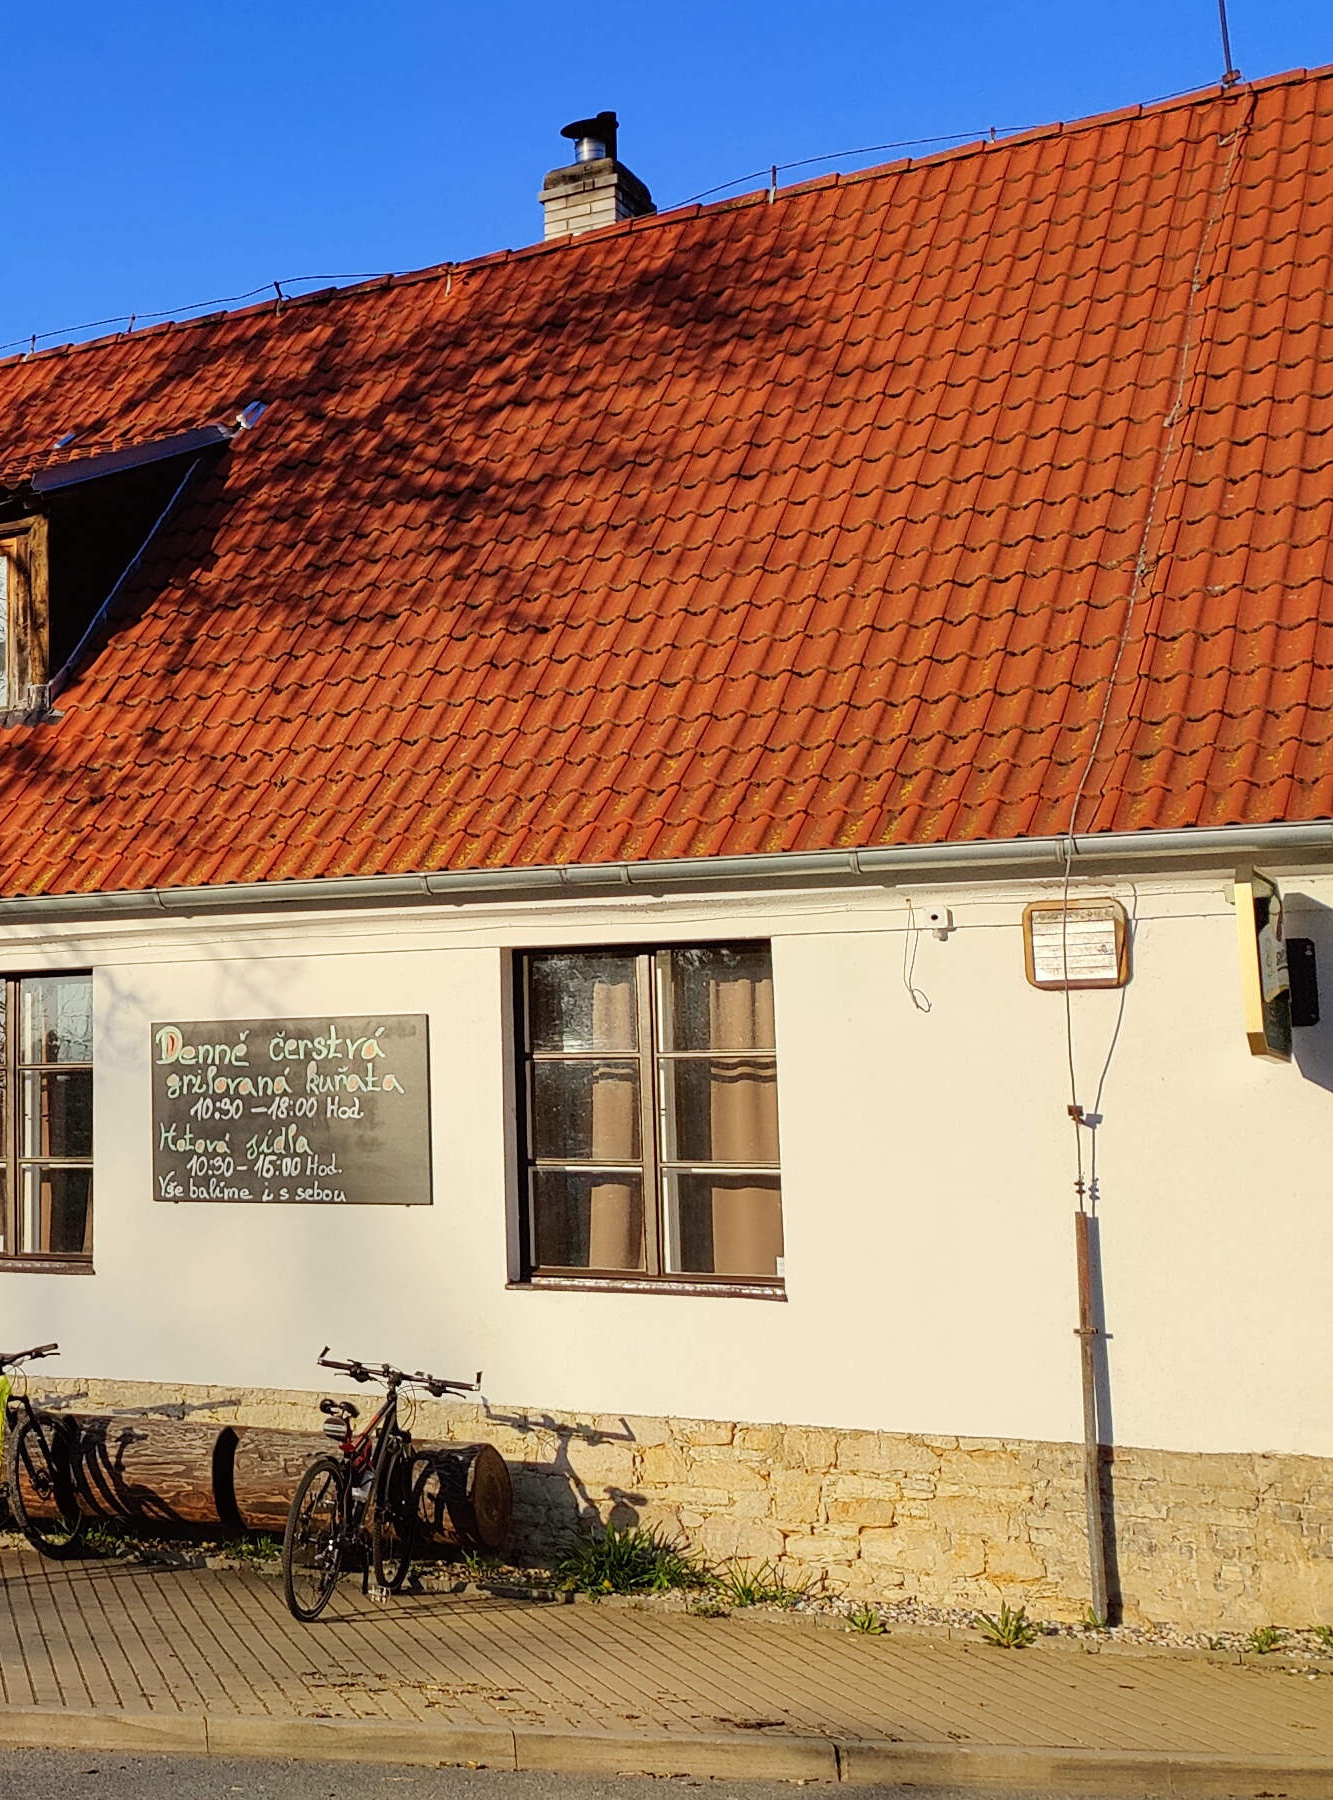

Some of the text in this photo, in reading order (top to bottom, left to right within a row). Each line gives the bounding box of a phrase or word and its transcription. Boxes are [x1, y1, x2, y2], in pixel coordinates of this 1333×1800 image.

[155, 1024, 386, 1067] Denně čerstvá
[166, 1060, 405, 1099] grilovaná kuřata
[190, 1096, 243, 1121] 10:30
[326, 1095, 365, 1119] Hod.
[159, 1122, 314, 1160] Hotová jídla
[186, 1154, 234, 1177] 10:30
[306, 1152, 343, 1176] Hod.
[158, 1171, 184, 1198] Vše
[262, 1181, 274, 1202] i
[279, 1187, 290, 1200] s
[295, 1180, 347, 1202] sebou
